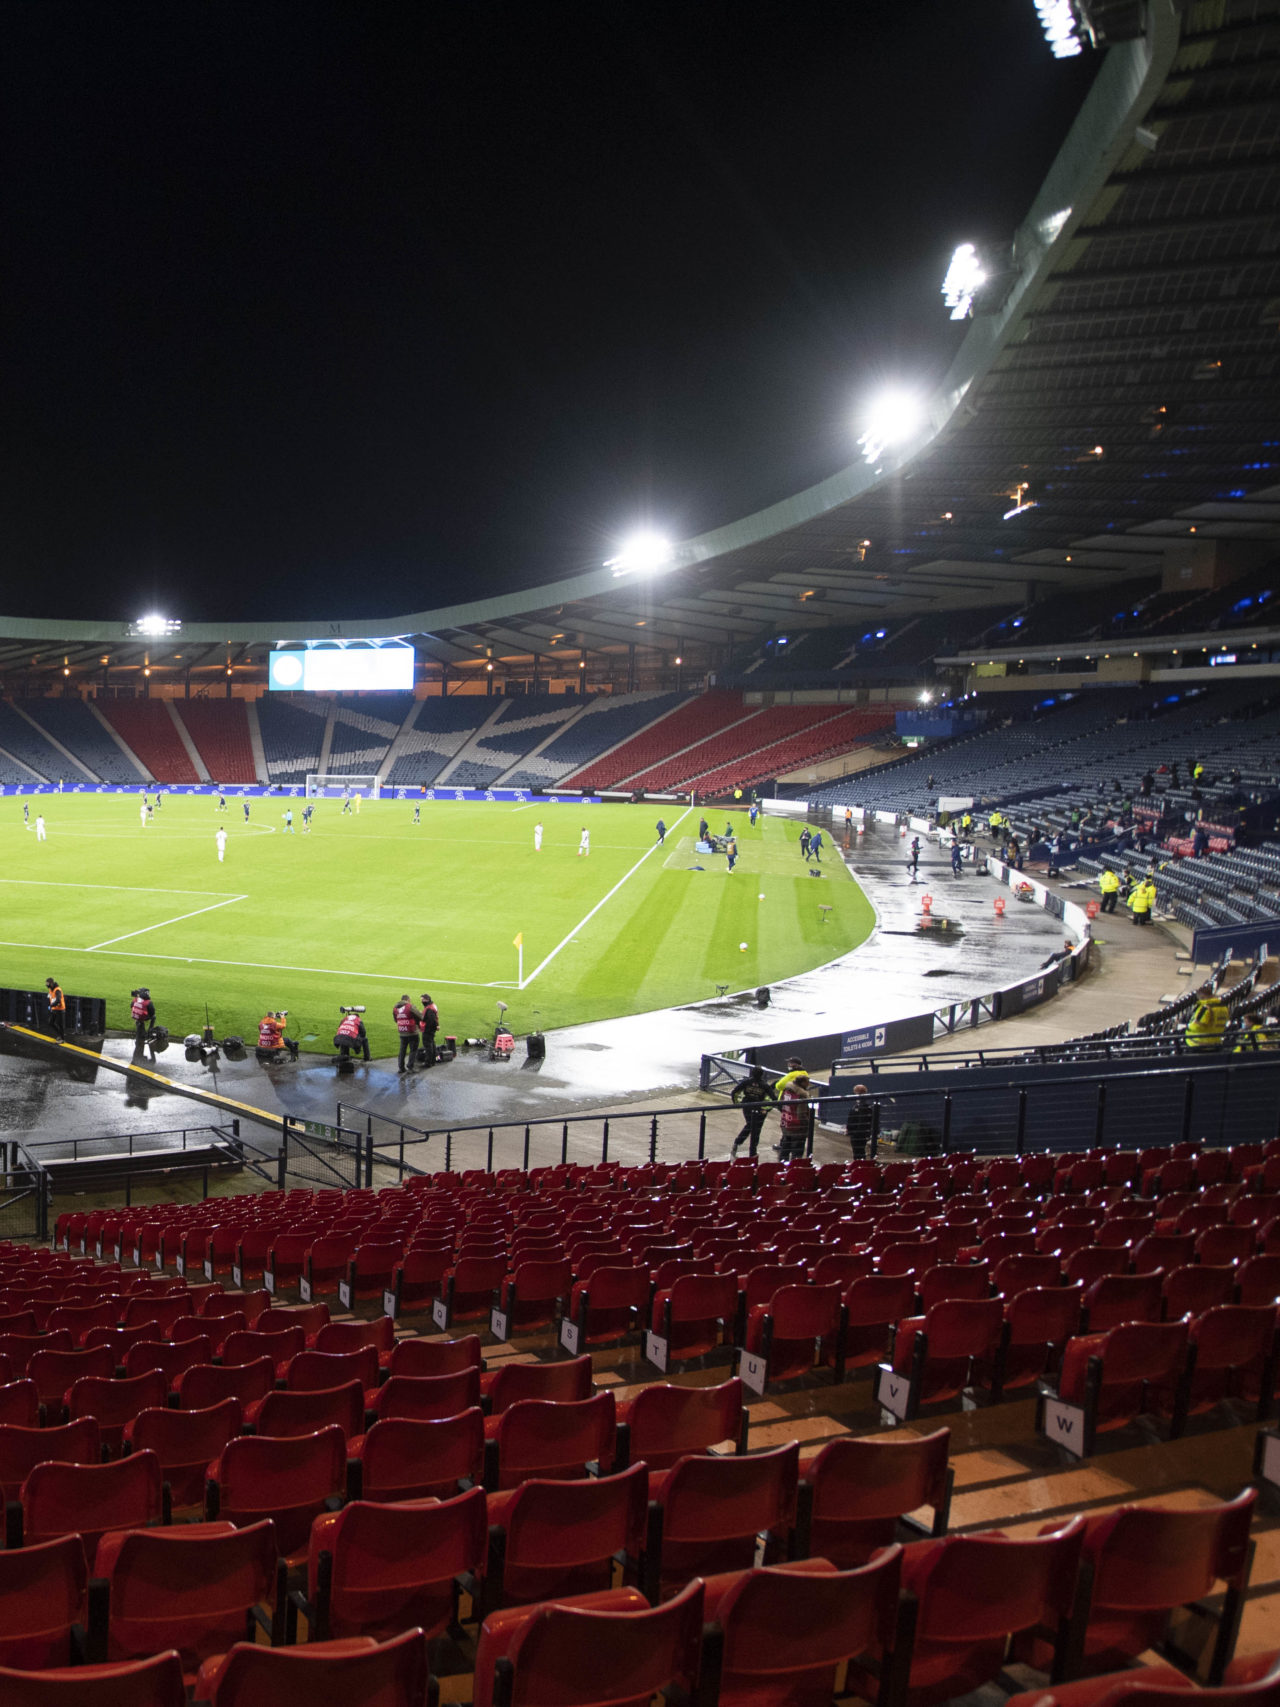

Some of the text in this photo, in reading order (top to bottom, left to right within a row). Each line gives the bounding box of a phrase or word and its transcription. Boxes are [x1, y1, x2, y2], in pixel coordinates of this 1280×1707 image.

[437, 1309, 444, 1319] Q
[496, 1319, 503, 1330] R
[566, 1328, 574, 1340] S
[653, 1344, 660, 1356] T
[748, 1362, 757, 1374] U
[890, 1384, 899, 1398] V
[1057, 1416, 1073, 1433] W
